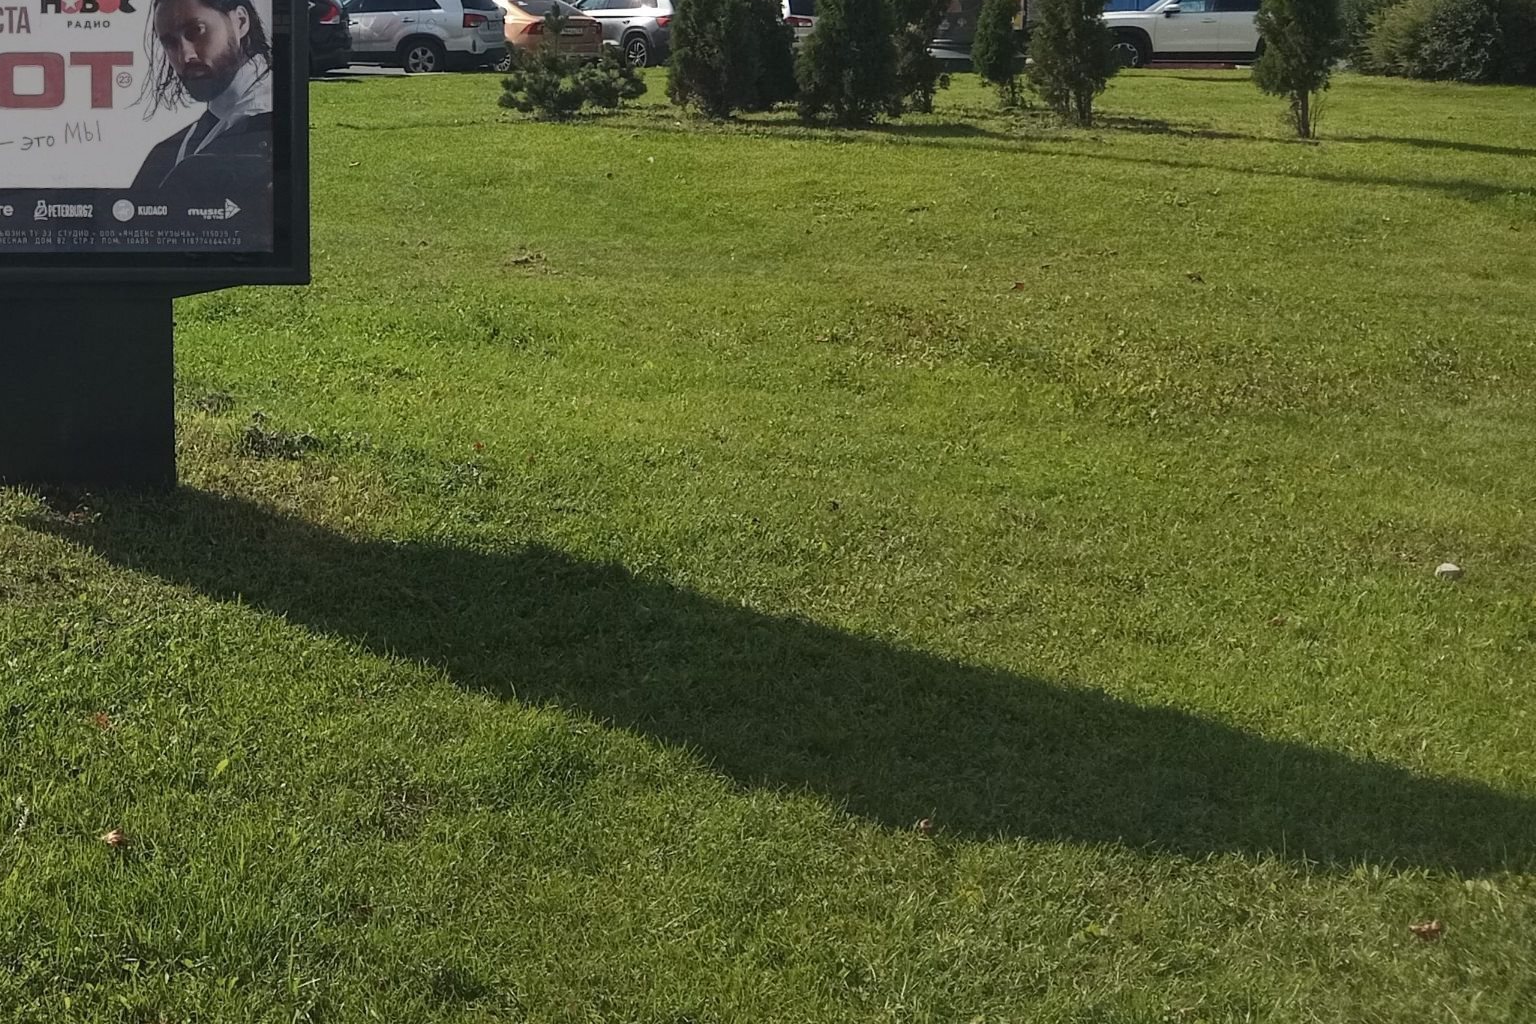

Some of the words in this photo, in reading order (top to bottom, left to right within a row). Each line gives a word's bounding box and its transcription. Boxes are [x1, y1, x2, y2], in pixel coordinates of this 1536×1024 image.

[67, 20, 111, 30] РАДИО
[20, 134, 56, 151] это
[64, 120, 101, 145] МЫ
[187, 207, 224, 216] music
